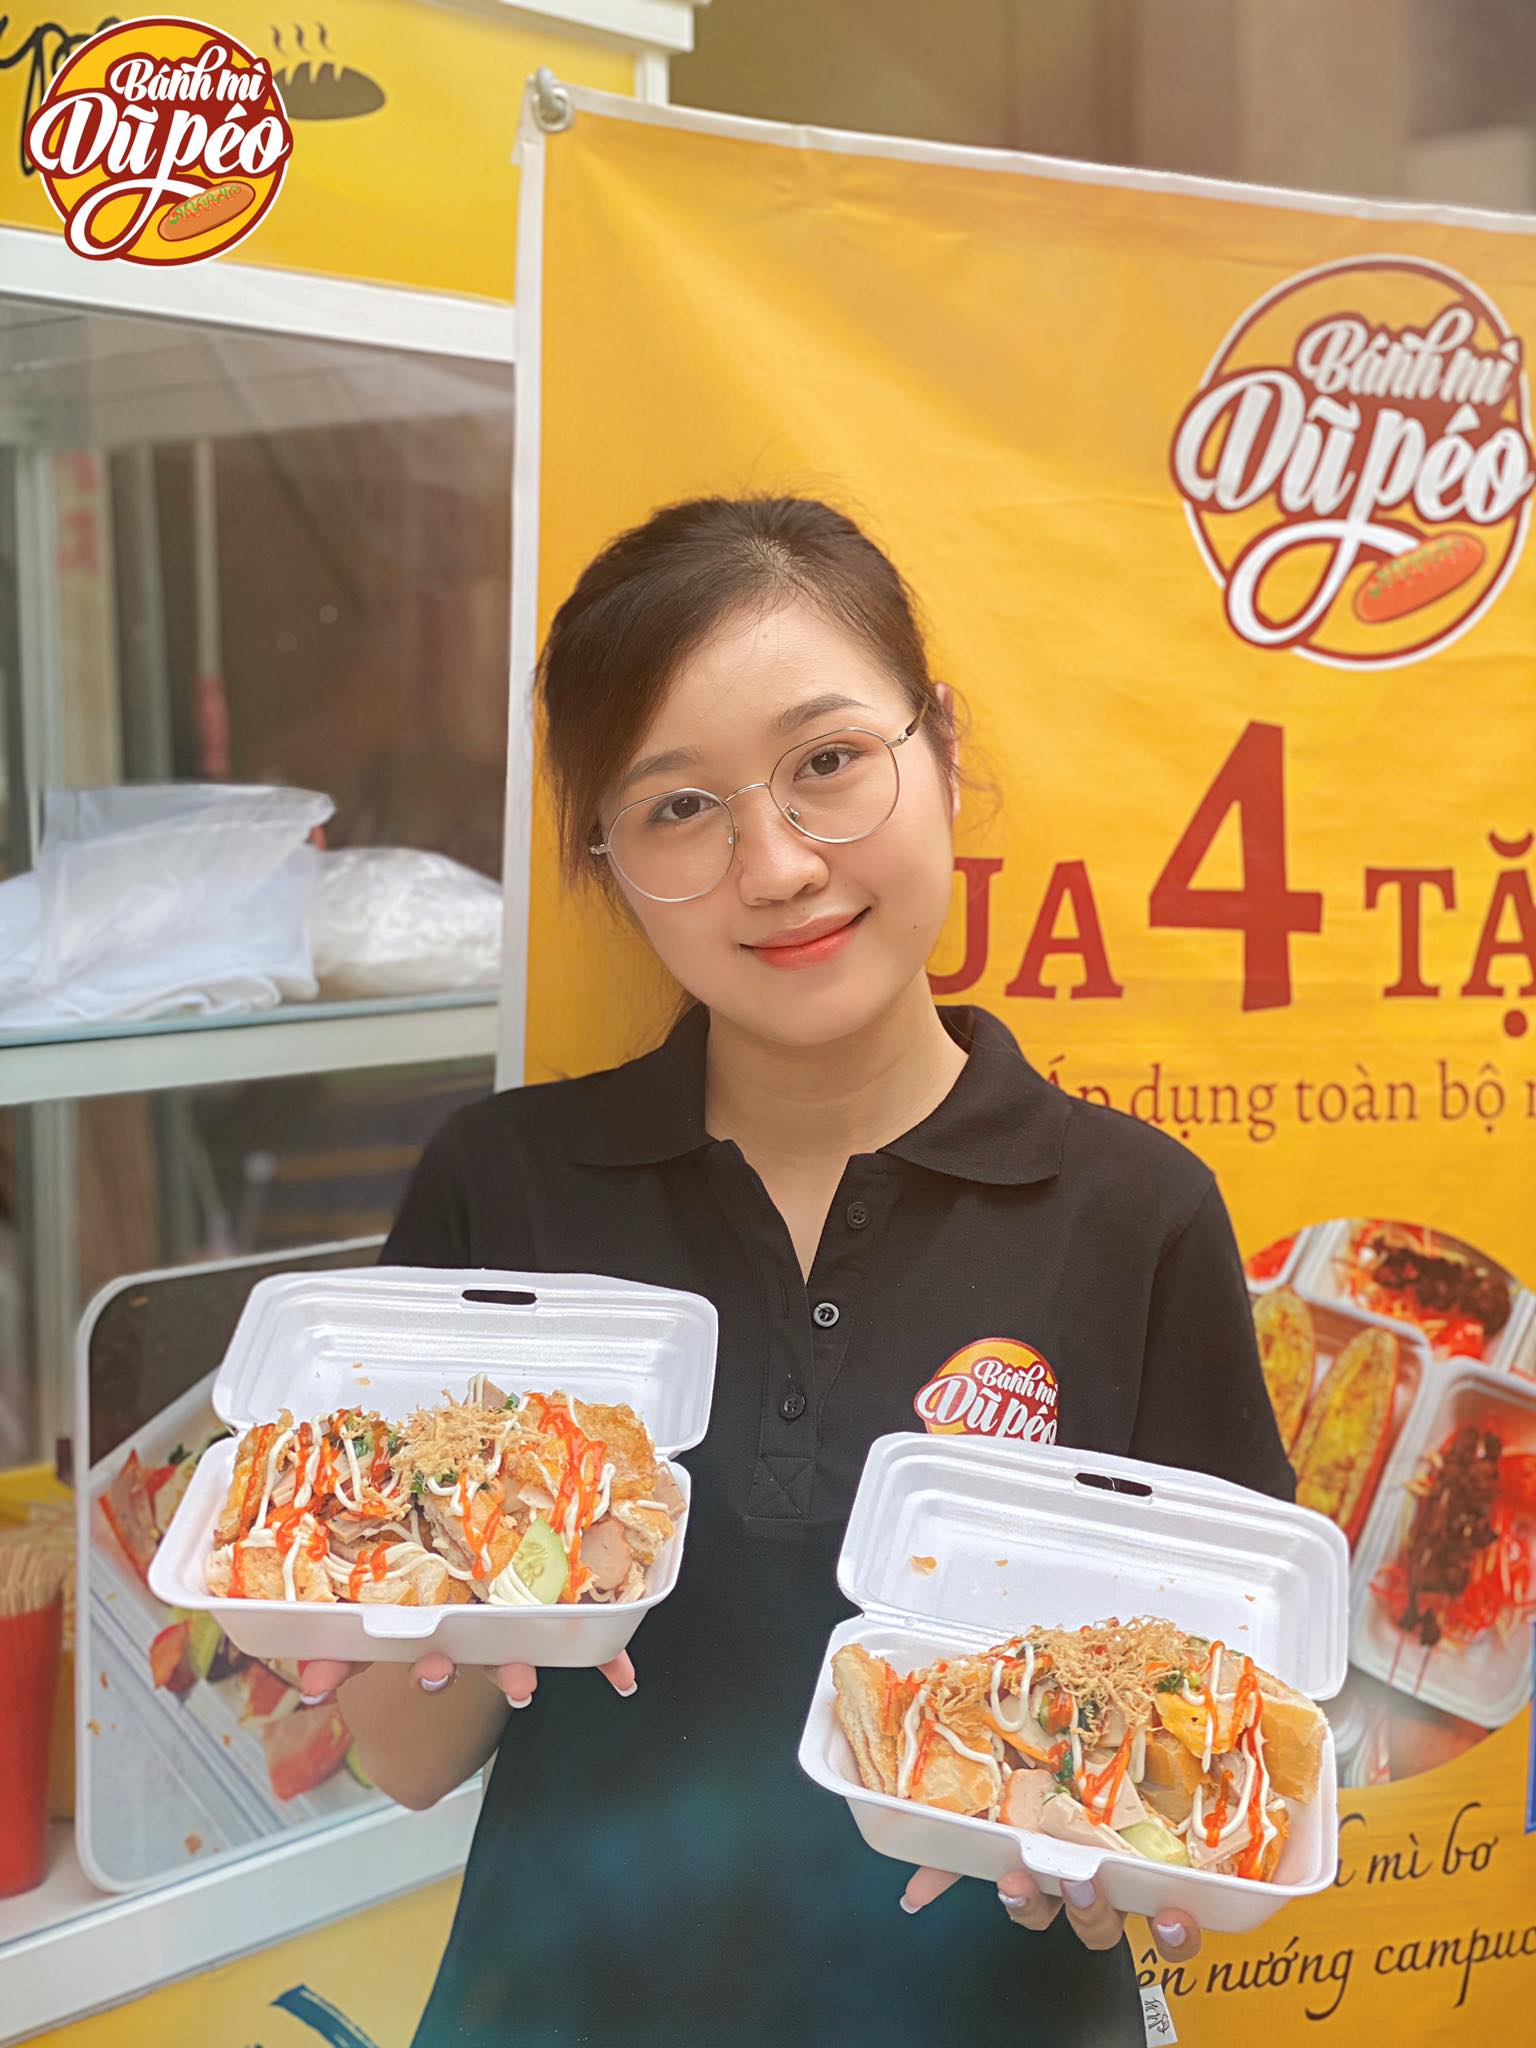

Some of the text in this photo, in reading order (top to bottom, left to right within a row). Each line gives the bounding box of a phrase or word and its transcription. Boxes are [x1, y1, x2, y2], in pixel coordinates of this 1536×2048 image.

[1296, 307, 1520, 407] Bánh mì
[1174, 369, 1362, 515] Dũ
[1147, 719, 1323, 1013] 4
[1362, 830, 1536, 1039] TẶ
[1130, 1061, 1279, 1143] dụng
[1294, 1061, 1419, 1124] toàn
[1437, 1058, 1506, 1134] bộ
[916, 1374, 1003, 1433] Dũ
[973, 1359, 1046, 1398] Bánh
[1366, 1832, 1434, 1885] mì
[1441, 1802, 1500, 1876] bơ
[1205, 1935, 1355, 2022] nướng
